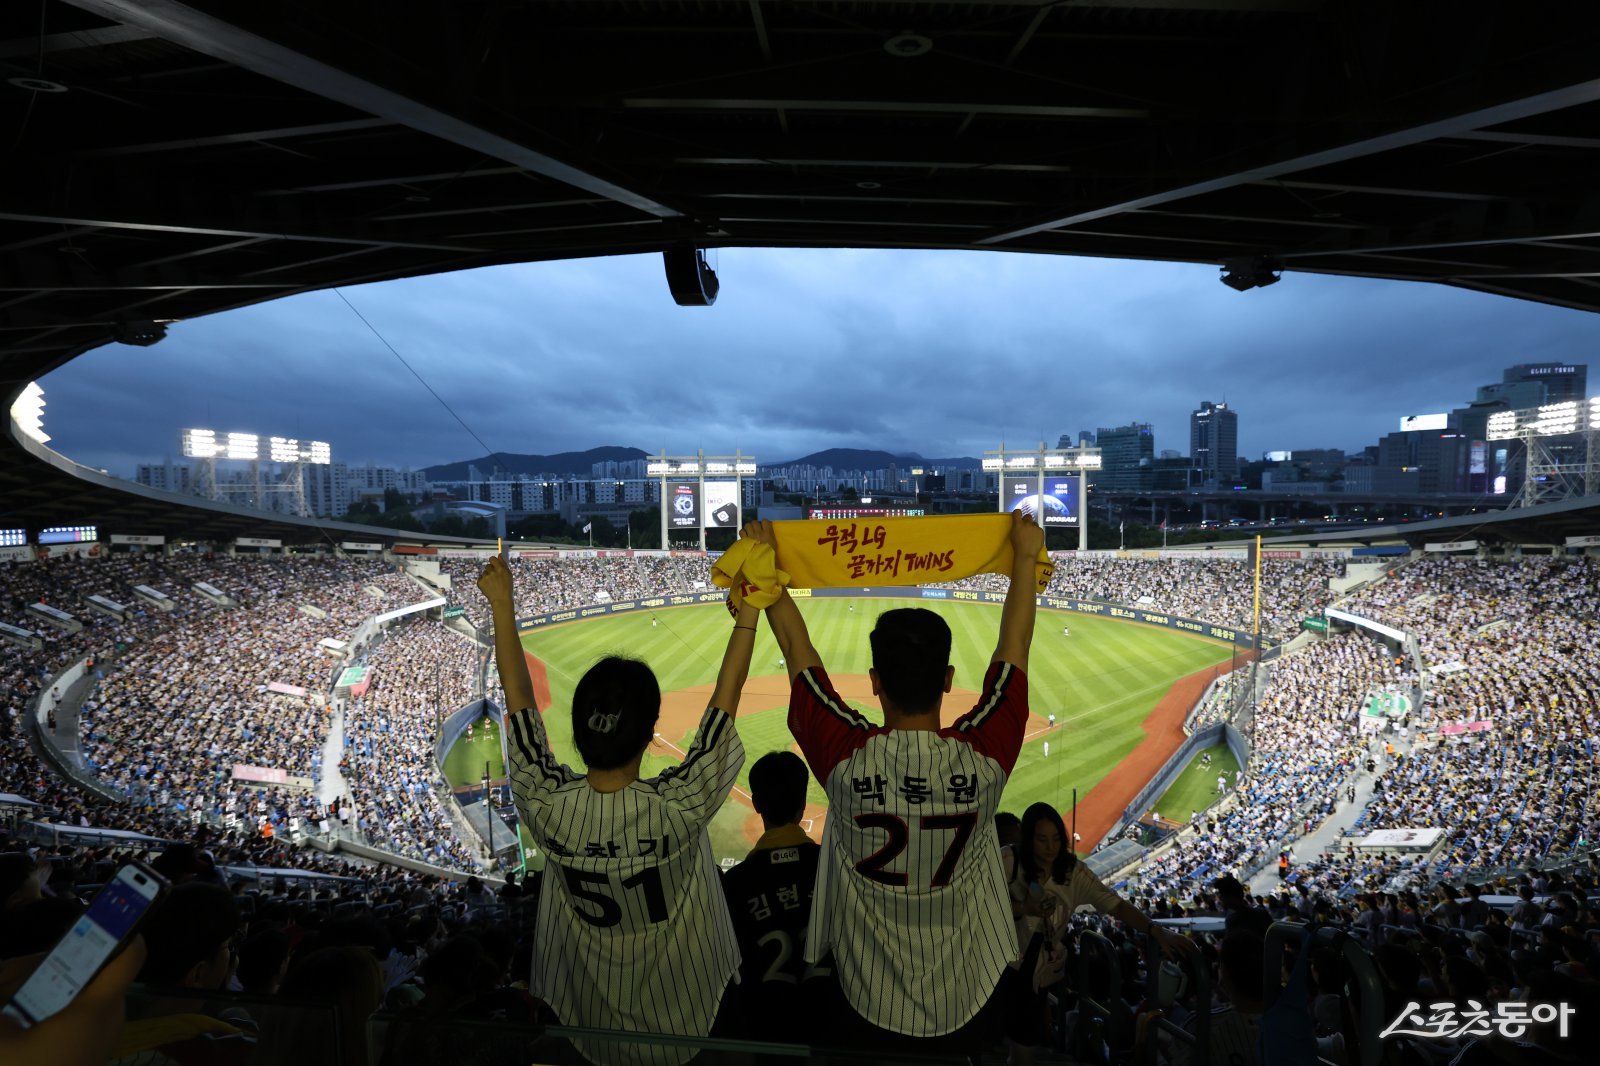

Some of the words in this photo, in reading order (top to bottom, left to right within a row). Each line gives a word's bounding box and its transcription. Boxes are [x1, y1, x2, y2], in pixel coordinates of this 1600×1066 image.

[818, 523, 858, 556] 무적
[862, 525, 886, 549] LG
[847, 549, 902, 579] 끝까지
[904, 549, 955, 572] TWINS
[1210, 627, 1236, 641] 키움증권
[852, 774, 978, 806] 박동원
[853, 812, 978, 887] 27
[561, 865, 669, 928] 51
[747, 883, 815, 921] 김현
